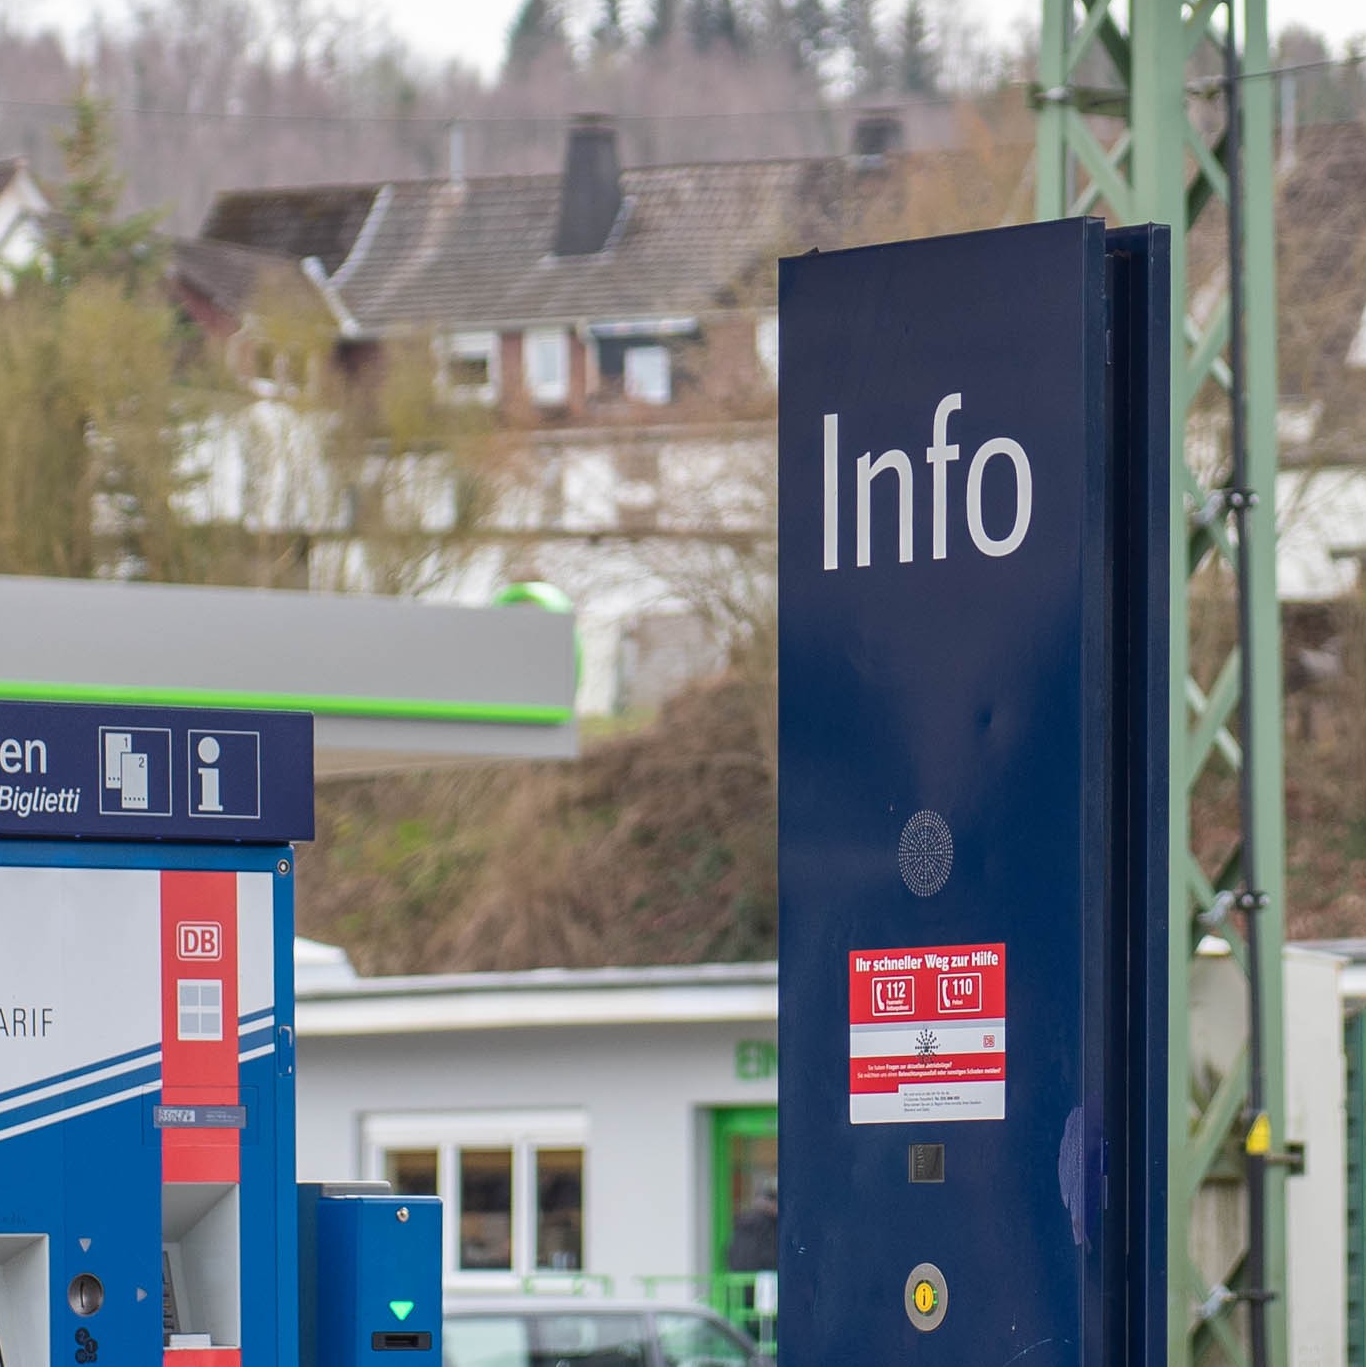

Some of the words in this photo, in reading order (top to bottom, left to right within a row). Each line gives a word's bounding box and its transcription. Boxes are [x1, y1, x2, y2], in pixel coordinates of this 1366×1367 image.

[824, 392, 1033, 572] Info
[180, 925, 219, 958] DB
[855, 957, 872, 973] Ihr
[873, 954, 923, 972] schneller
[924, 953, 950, 972] Weg
[951, 955, 968, 968] zur
[971, 951, 999, 967] Hilfe
[886, 981, 907, 999] 112
[952, 978, 973, 996] 110
